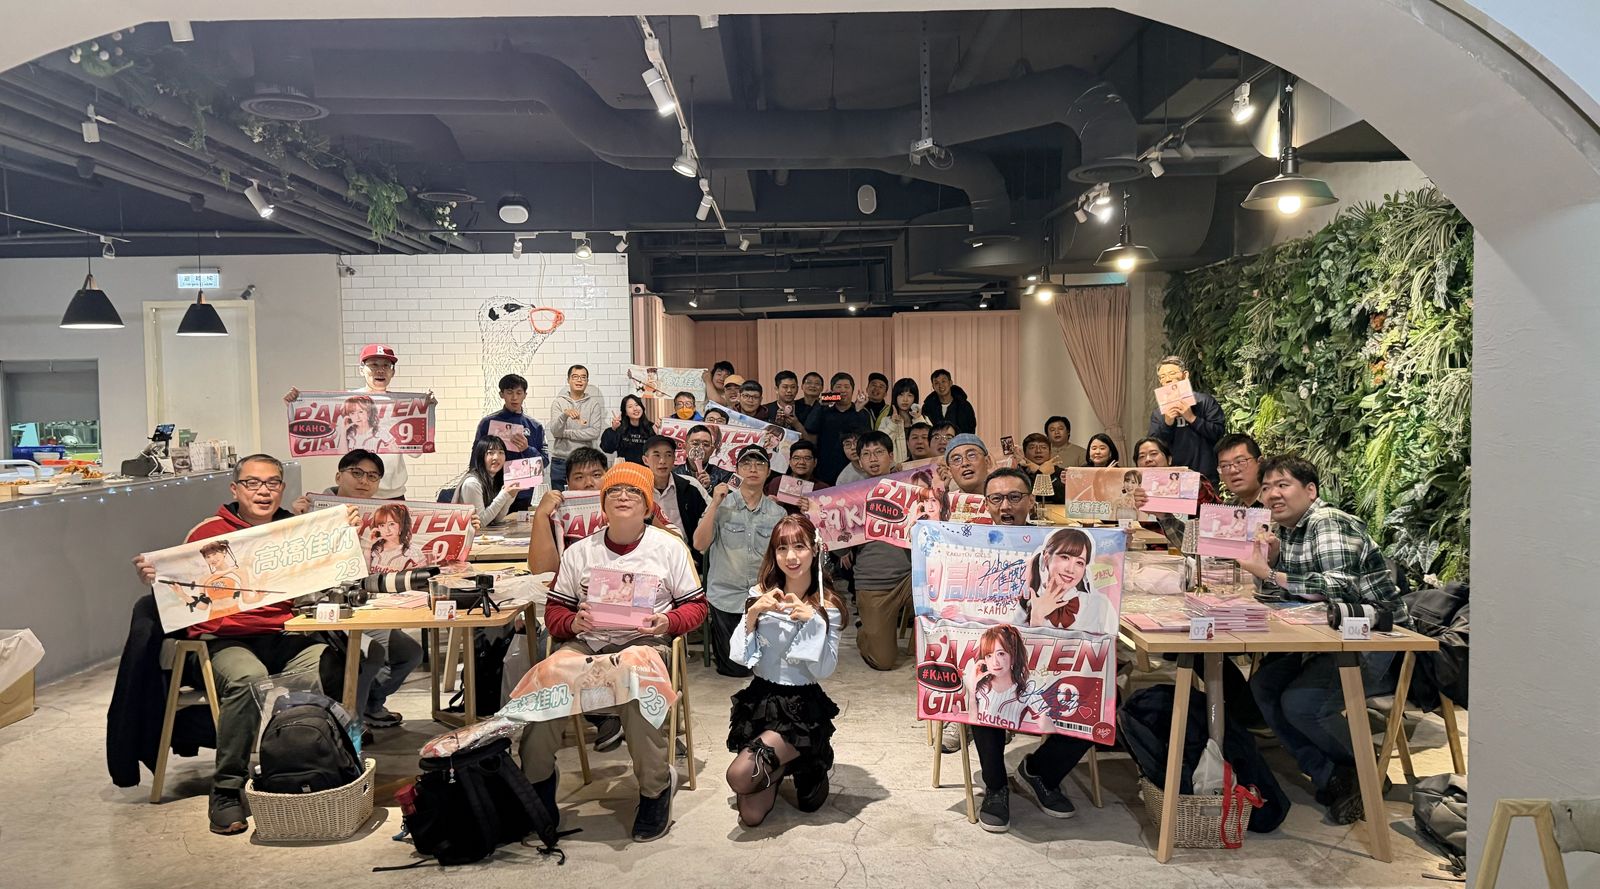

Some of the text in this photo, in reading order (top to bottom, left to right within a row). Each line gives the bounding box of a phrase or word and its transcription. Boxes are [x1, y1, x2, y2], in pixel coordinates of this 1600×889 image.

[292, 423, 326, 433] #KAHO
[398, 423, 414, 444] 9
[869, 502, 899, 517] #KAHO
[254, 526, 353, 574] 高橋佳帆
[431, 540, 450, 563] 9
[335, 557, 361, 581] 23
[925, 637, 1110, 673] RAKTEN
[922, 669, 957, 684] #KAHO
[640, 686, 666, 716] 23
[1057, 683, 1080, 718] 9
[977, 711, 1015, 729] akuten
